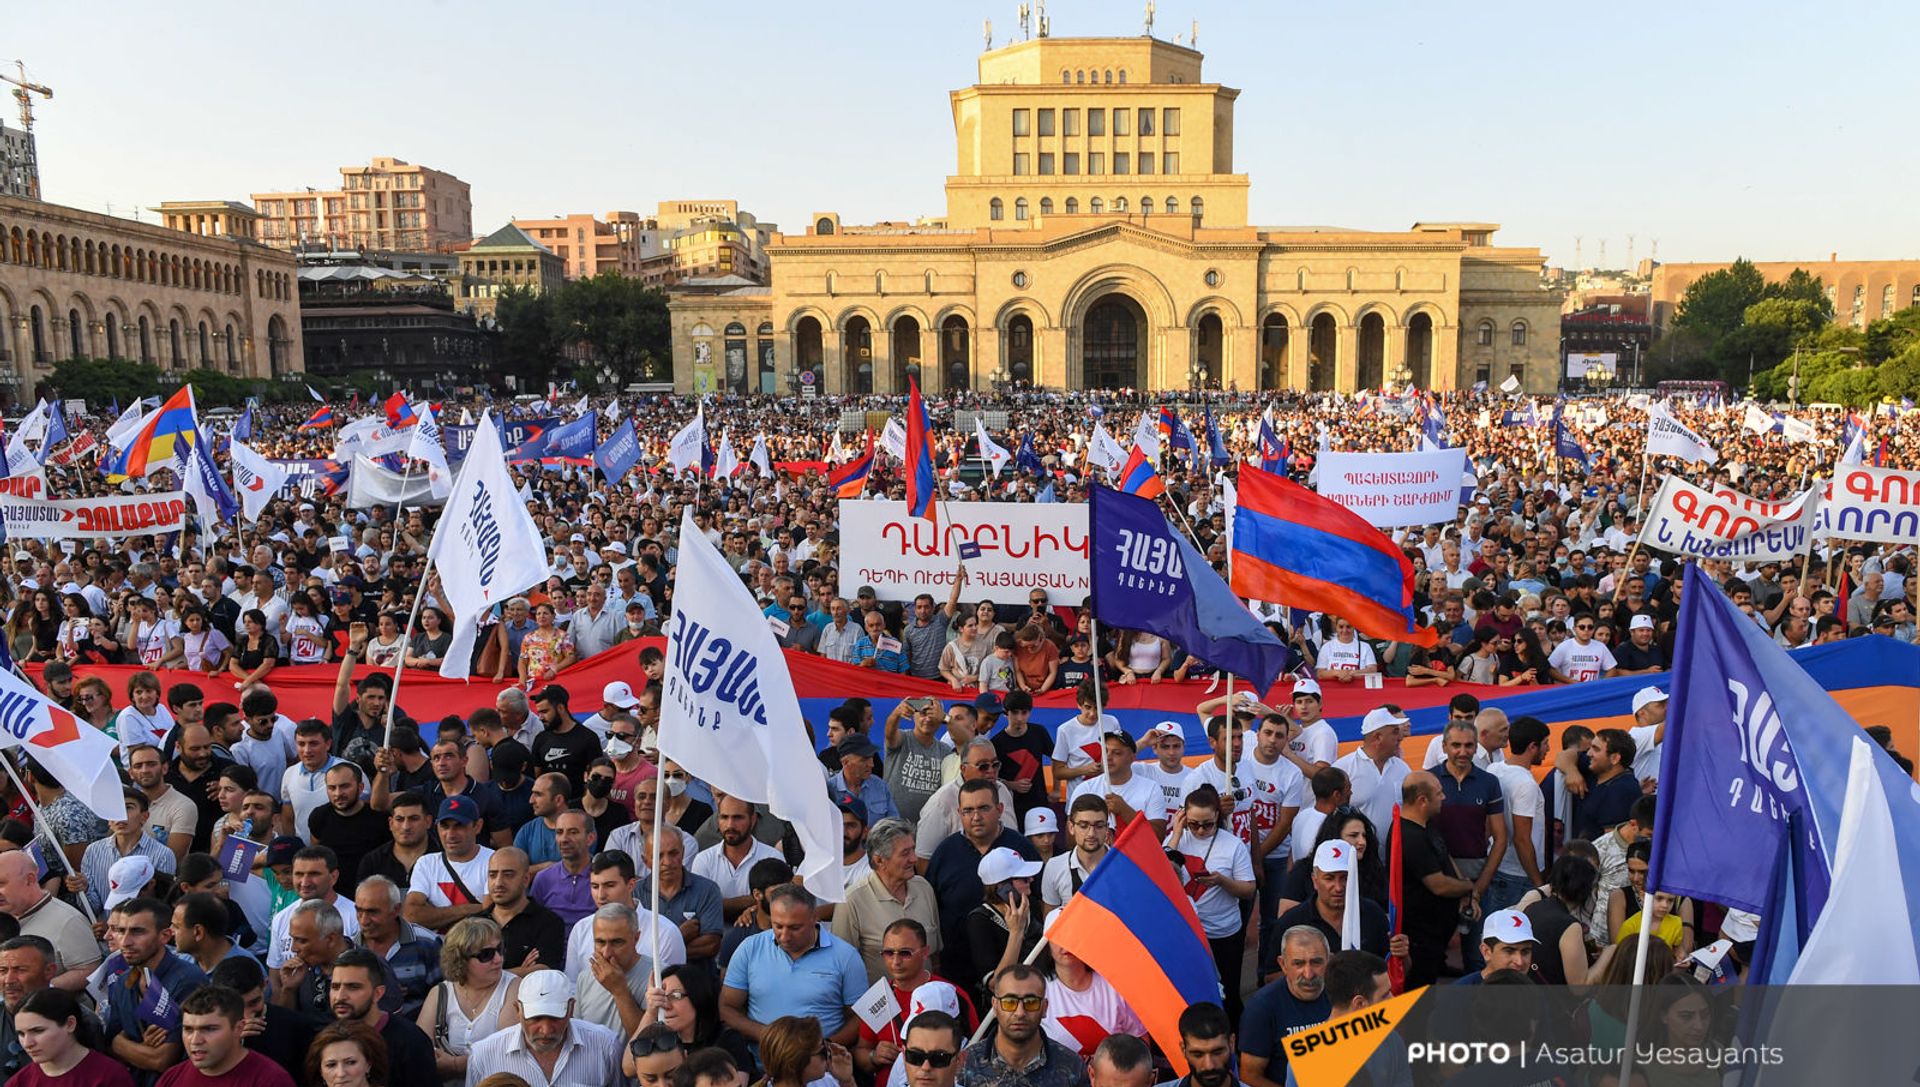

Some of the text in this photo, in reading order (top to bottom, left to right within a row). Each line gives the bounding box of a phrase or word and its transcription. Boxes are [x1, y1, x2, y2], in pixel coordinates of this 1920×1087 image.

[4, 499, 185, 532] ՀԱՅԱՍՏԱՆ ԶՈԼԱՔԱՐ
[859, 569, 908, 585] ԴԵՊԻ
[976, 571, 1074, 588] ՀԱՅԱՍՏԱՆ
[1118, 572, 1177, 596] ԴԱՇԻՆՔ
